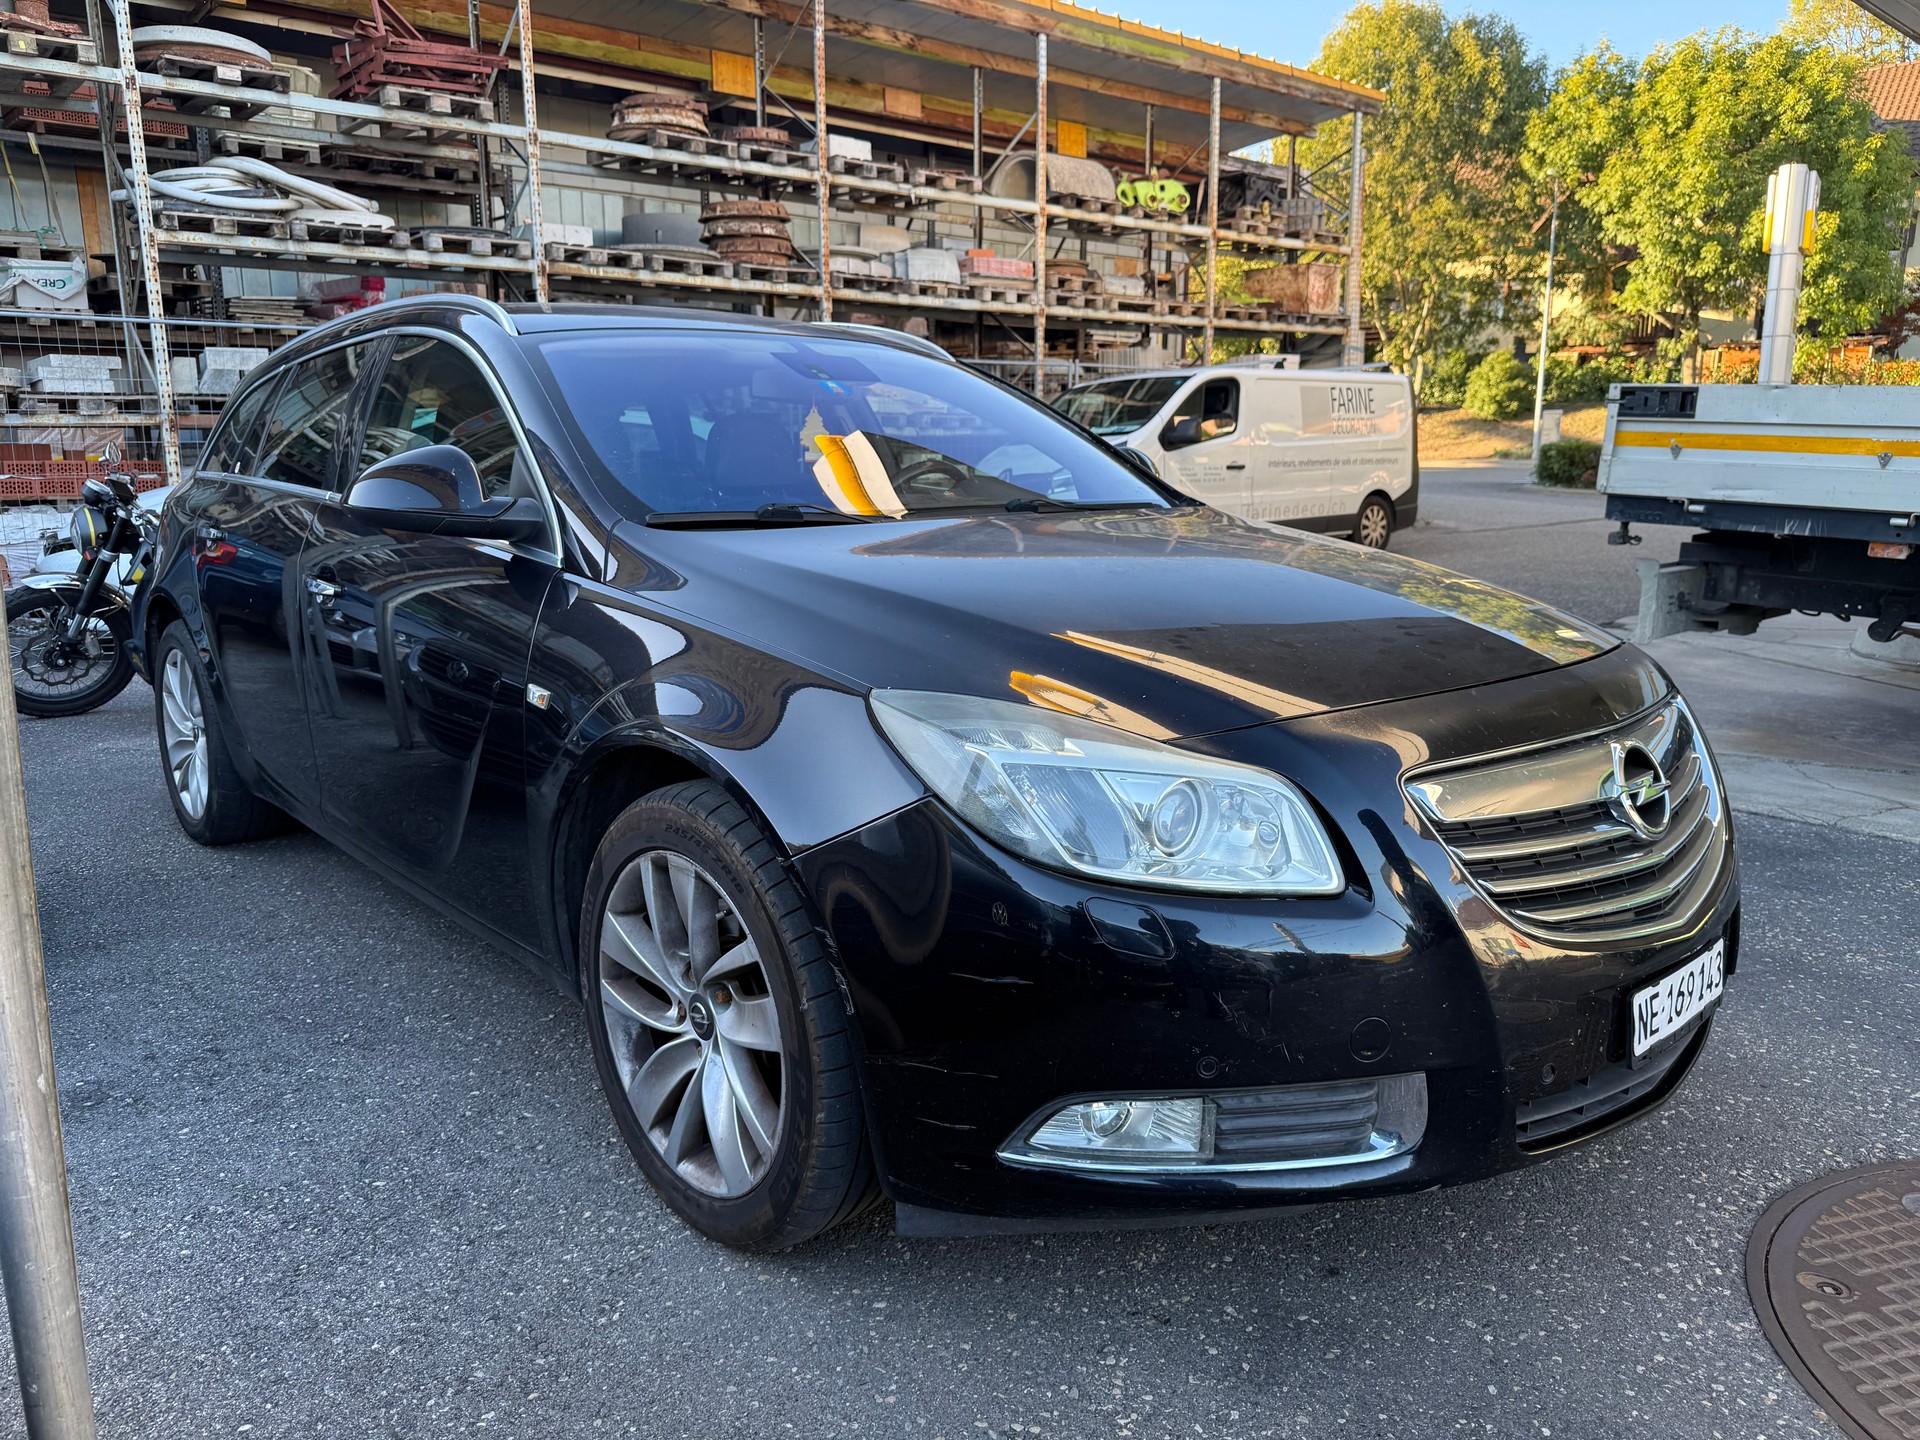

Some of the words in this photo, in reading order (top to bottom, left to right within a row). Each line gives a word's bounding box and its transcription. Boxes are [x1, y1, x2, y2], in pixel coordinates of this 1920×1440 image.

[1330, 386, 1375, 414] FARINE
[1331, 416, 1376, 435] DÉCORATION
[664, 823, 711, 855] 245/45
